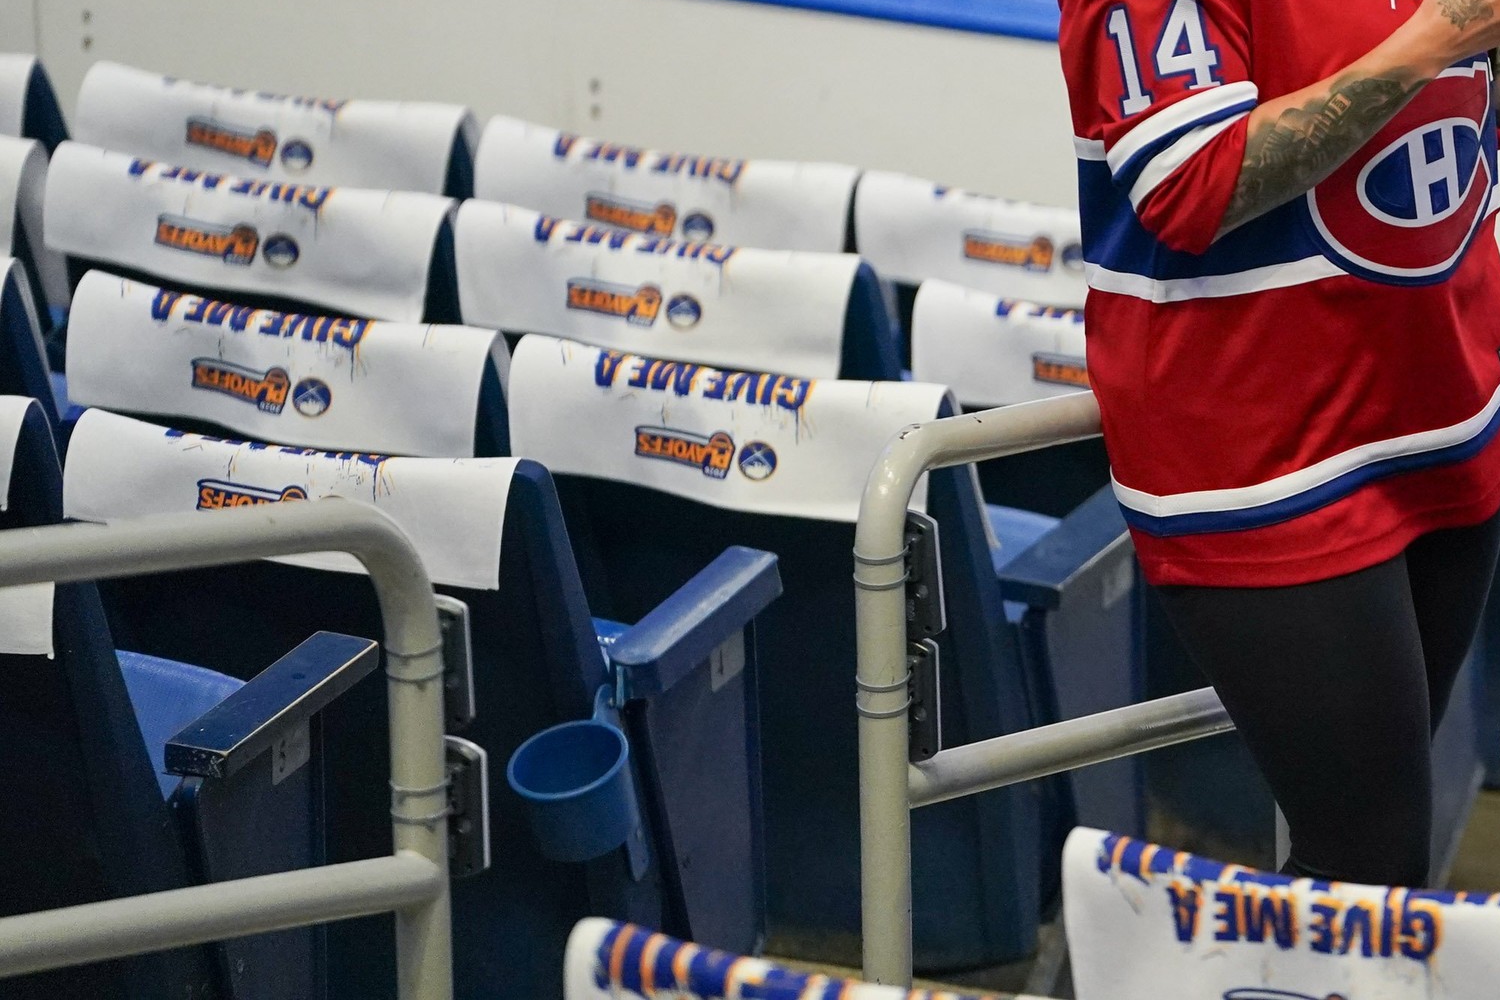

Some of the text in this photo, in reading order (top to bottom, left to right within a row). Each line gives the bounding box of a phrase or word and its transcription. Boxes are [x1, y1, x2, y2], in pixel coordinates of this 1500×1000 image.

[594, 349, 815, 412] GIVE ME A
[637, 430, 732, 468] PLAYOFFS
[1166, 879, 1445, 961] GIVE ME A
